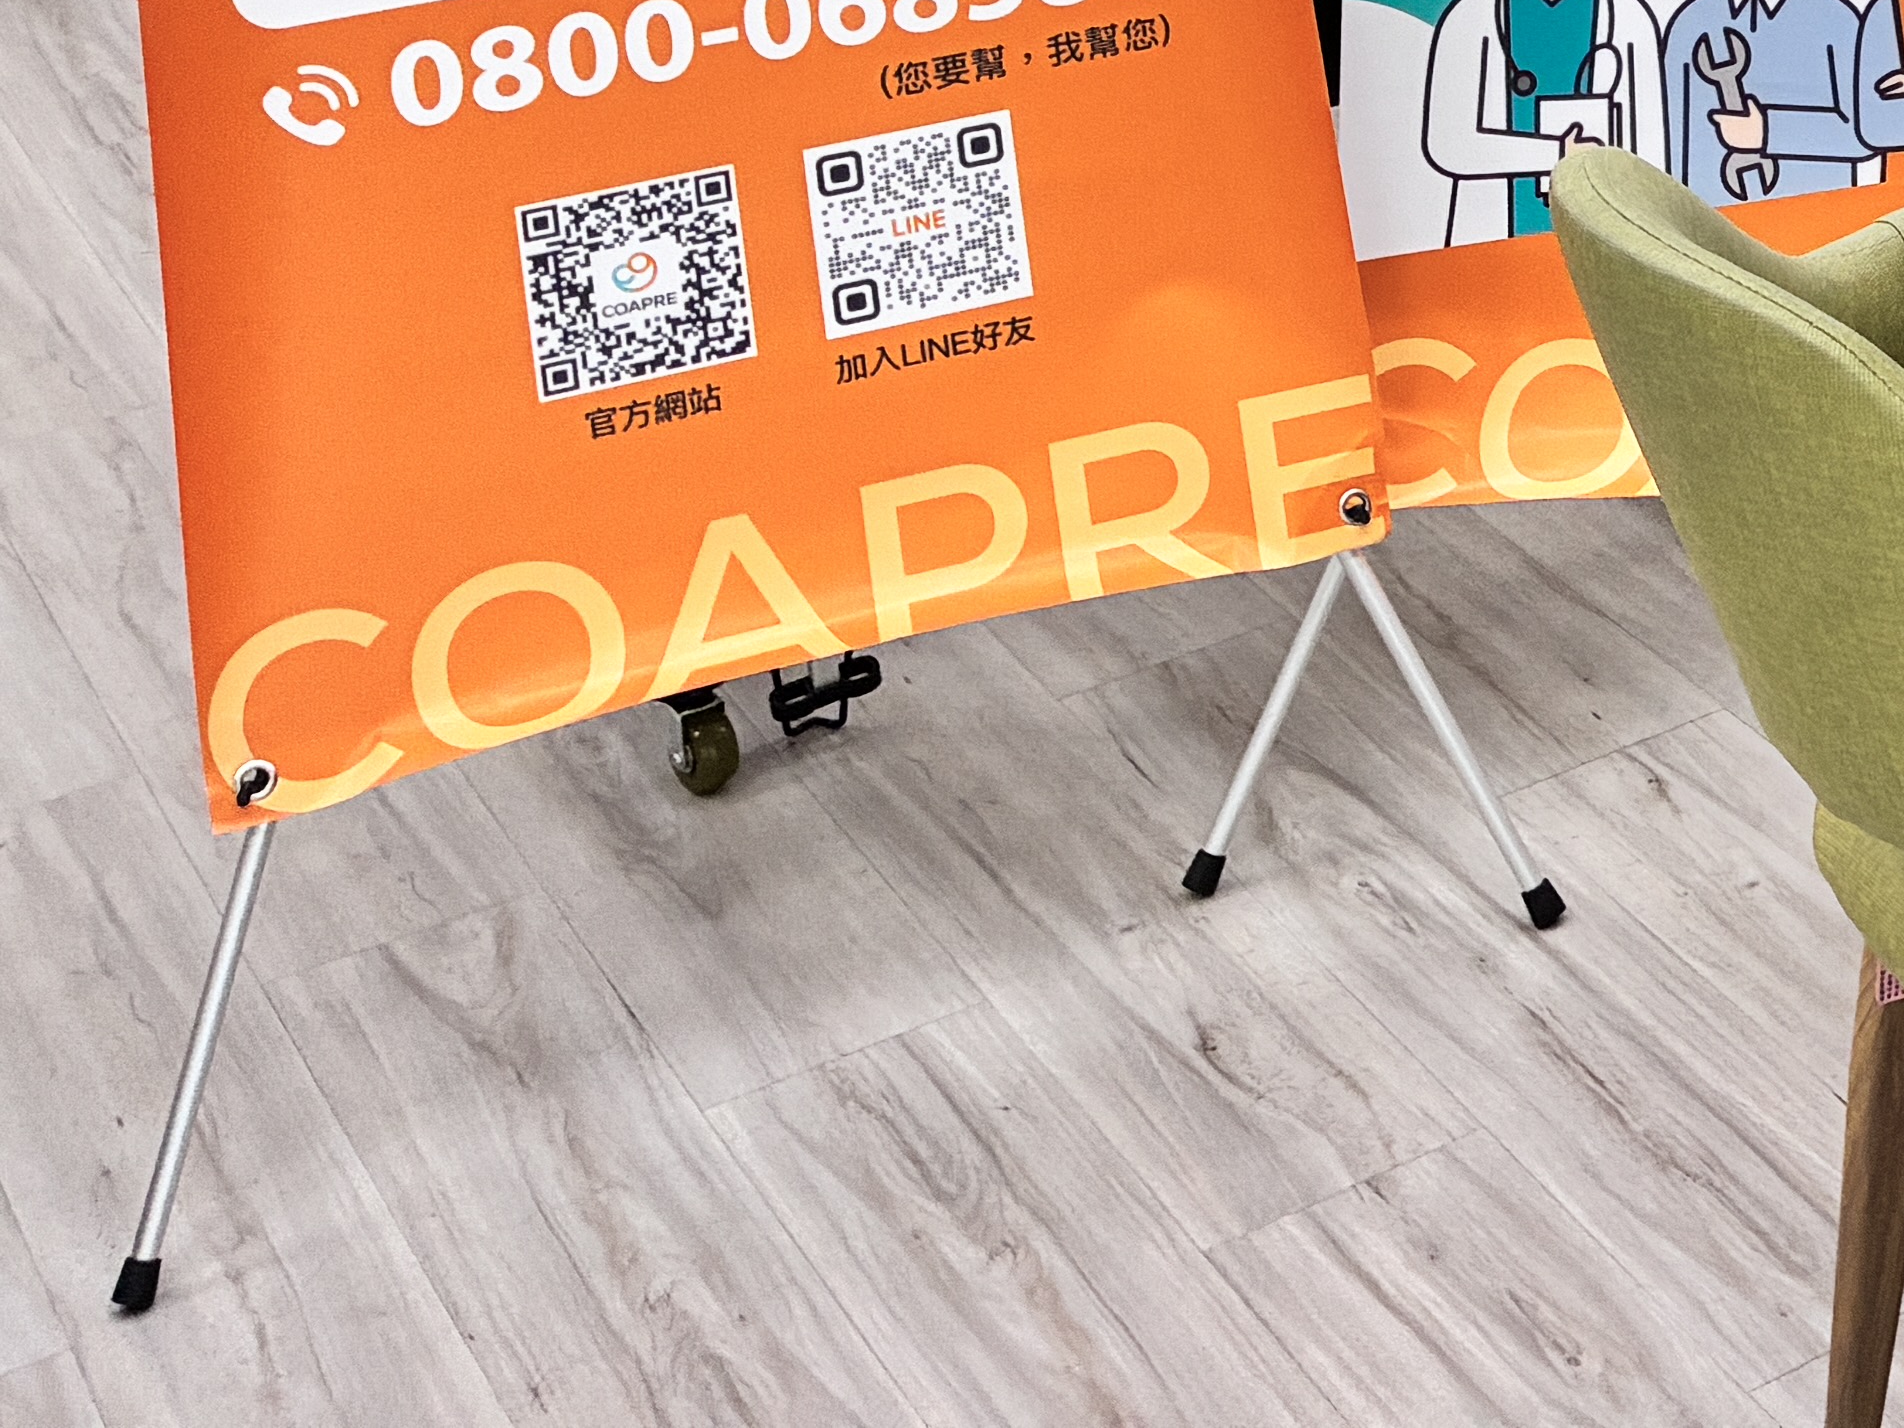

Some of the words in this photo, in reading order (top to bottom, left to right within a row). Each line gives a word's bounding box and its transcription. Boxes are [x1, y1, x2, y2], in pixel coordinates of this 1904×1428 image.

[889, 207, 948, 242] LINE
[600, 287, 680, 322] COAPRE
[833, 312, 1039, 387] 加入LINE好友
[583, 382, 726, 442] 官方網站
[206, 374, 1386, 816] COAPRE
